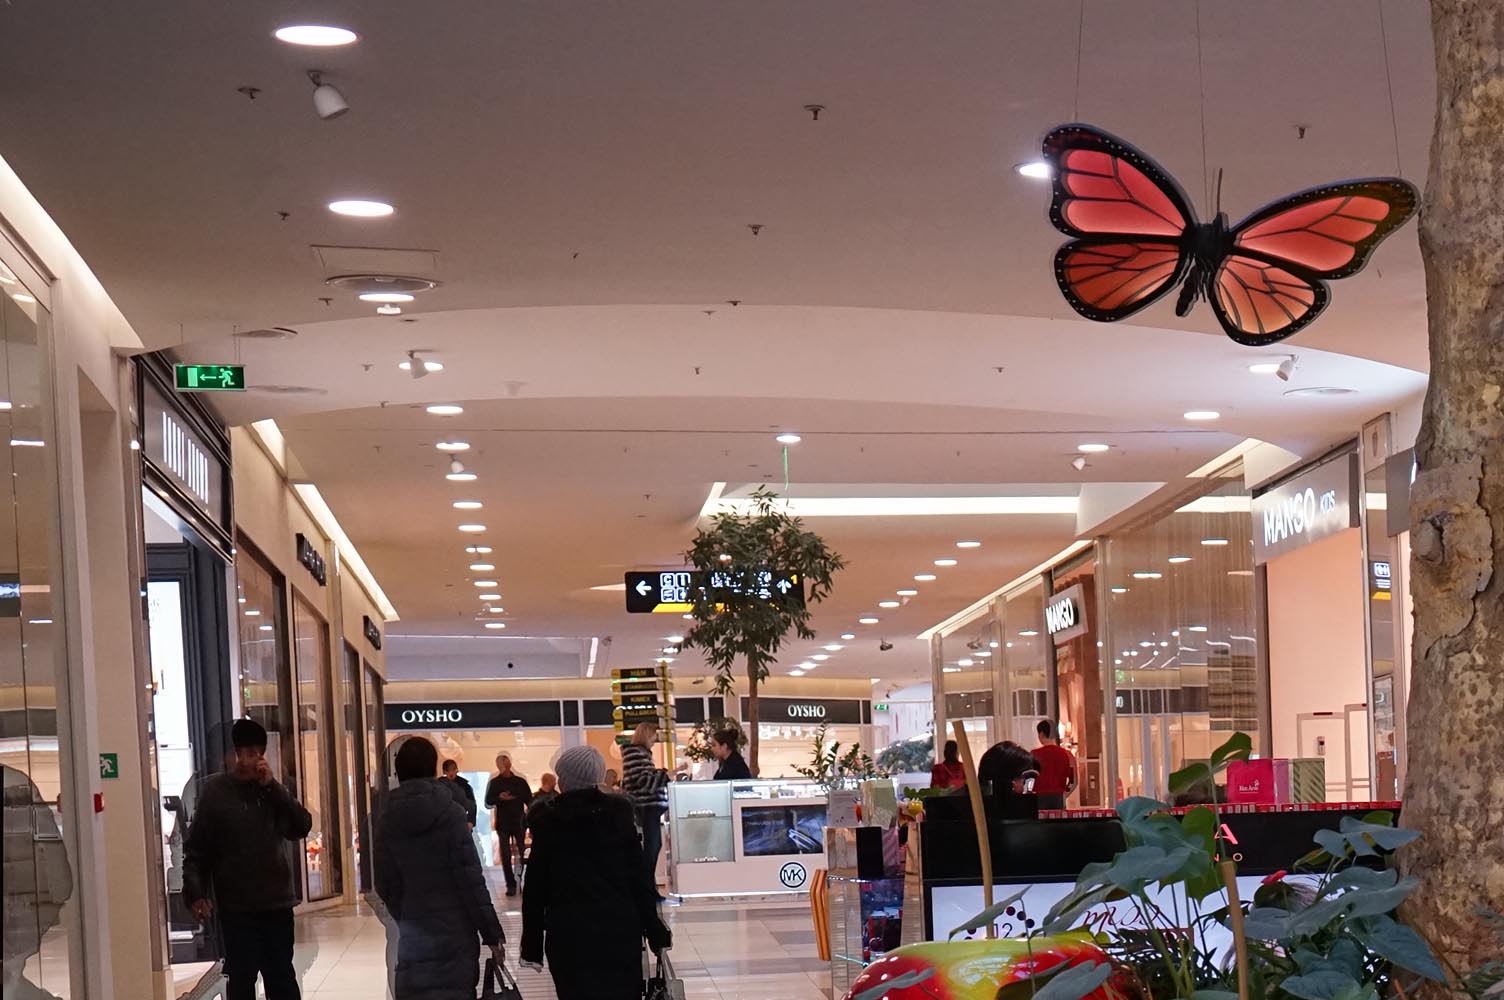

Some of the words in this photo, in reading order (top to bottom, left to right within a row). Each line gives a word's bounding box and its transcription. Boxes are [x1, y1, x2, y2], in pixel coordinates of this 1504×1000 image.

[1263, 487, 1316, 547] MANGO
[1045, 597, 1075, 635] MANGO
[401, 709, 463, 724] OYSHO
[787, 704, 826, 718] OYSHO
[783, 869, 802, 881] MK
